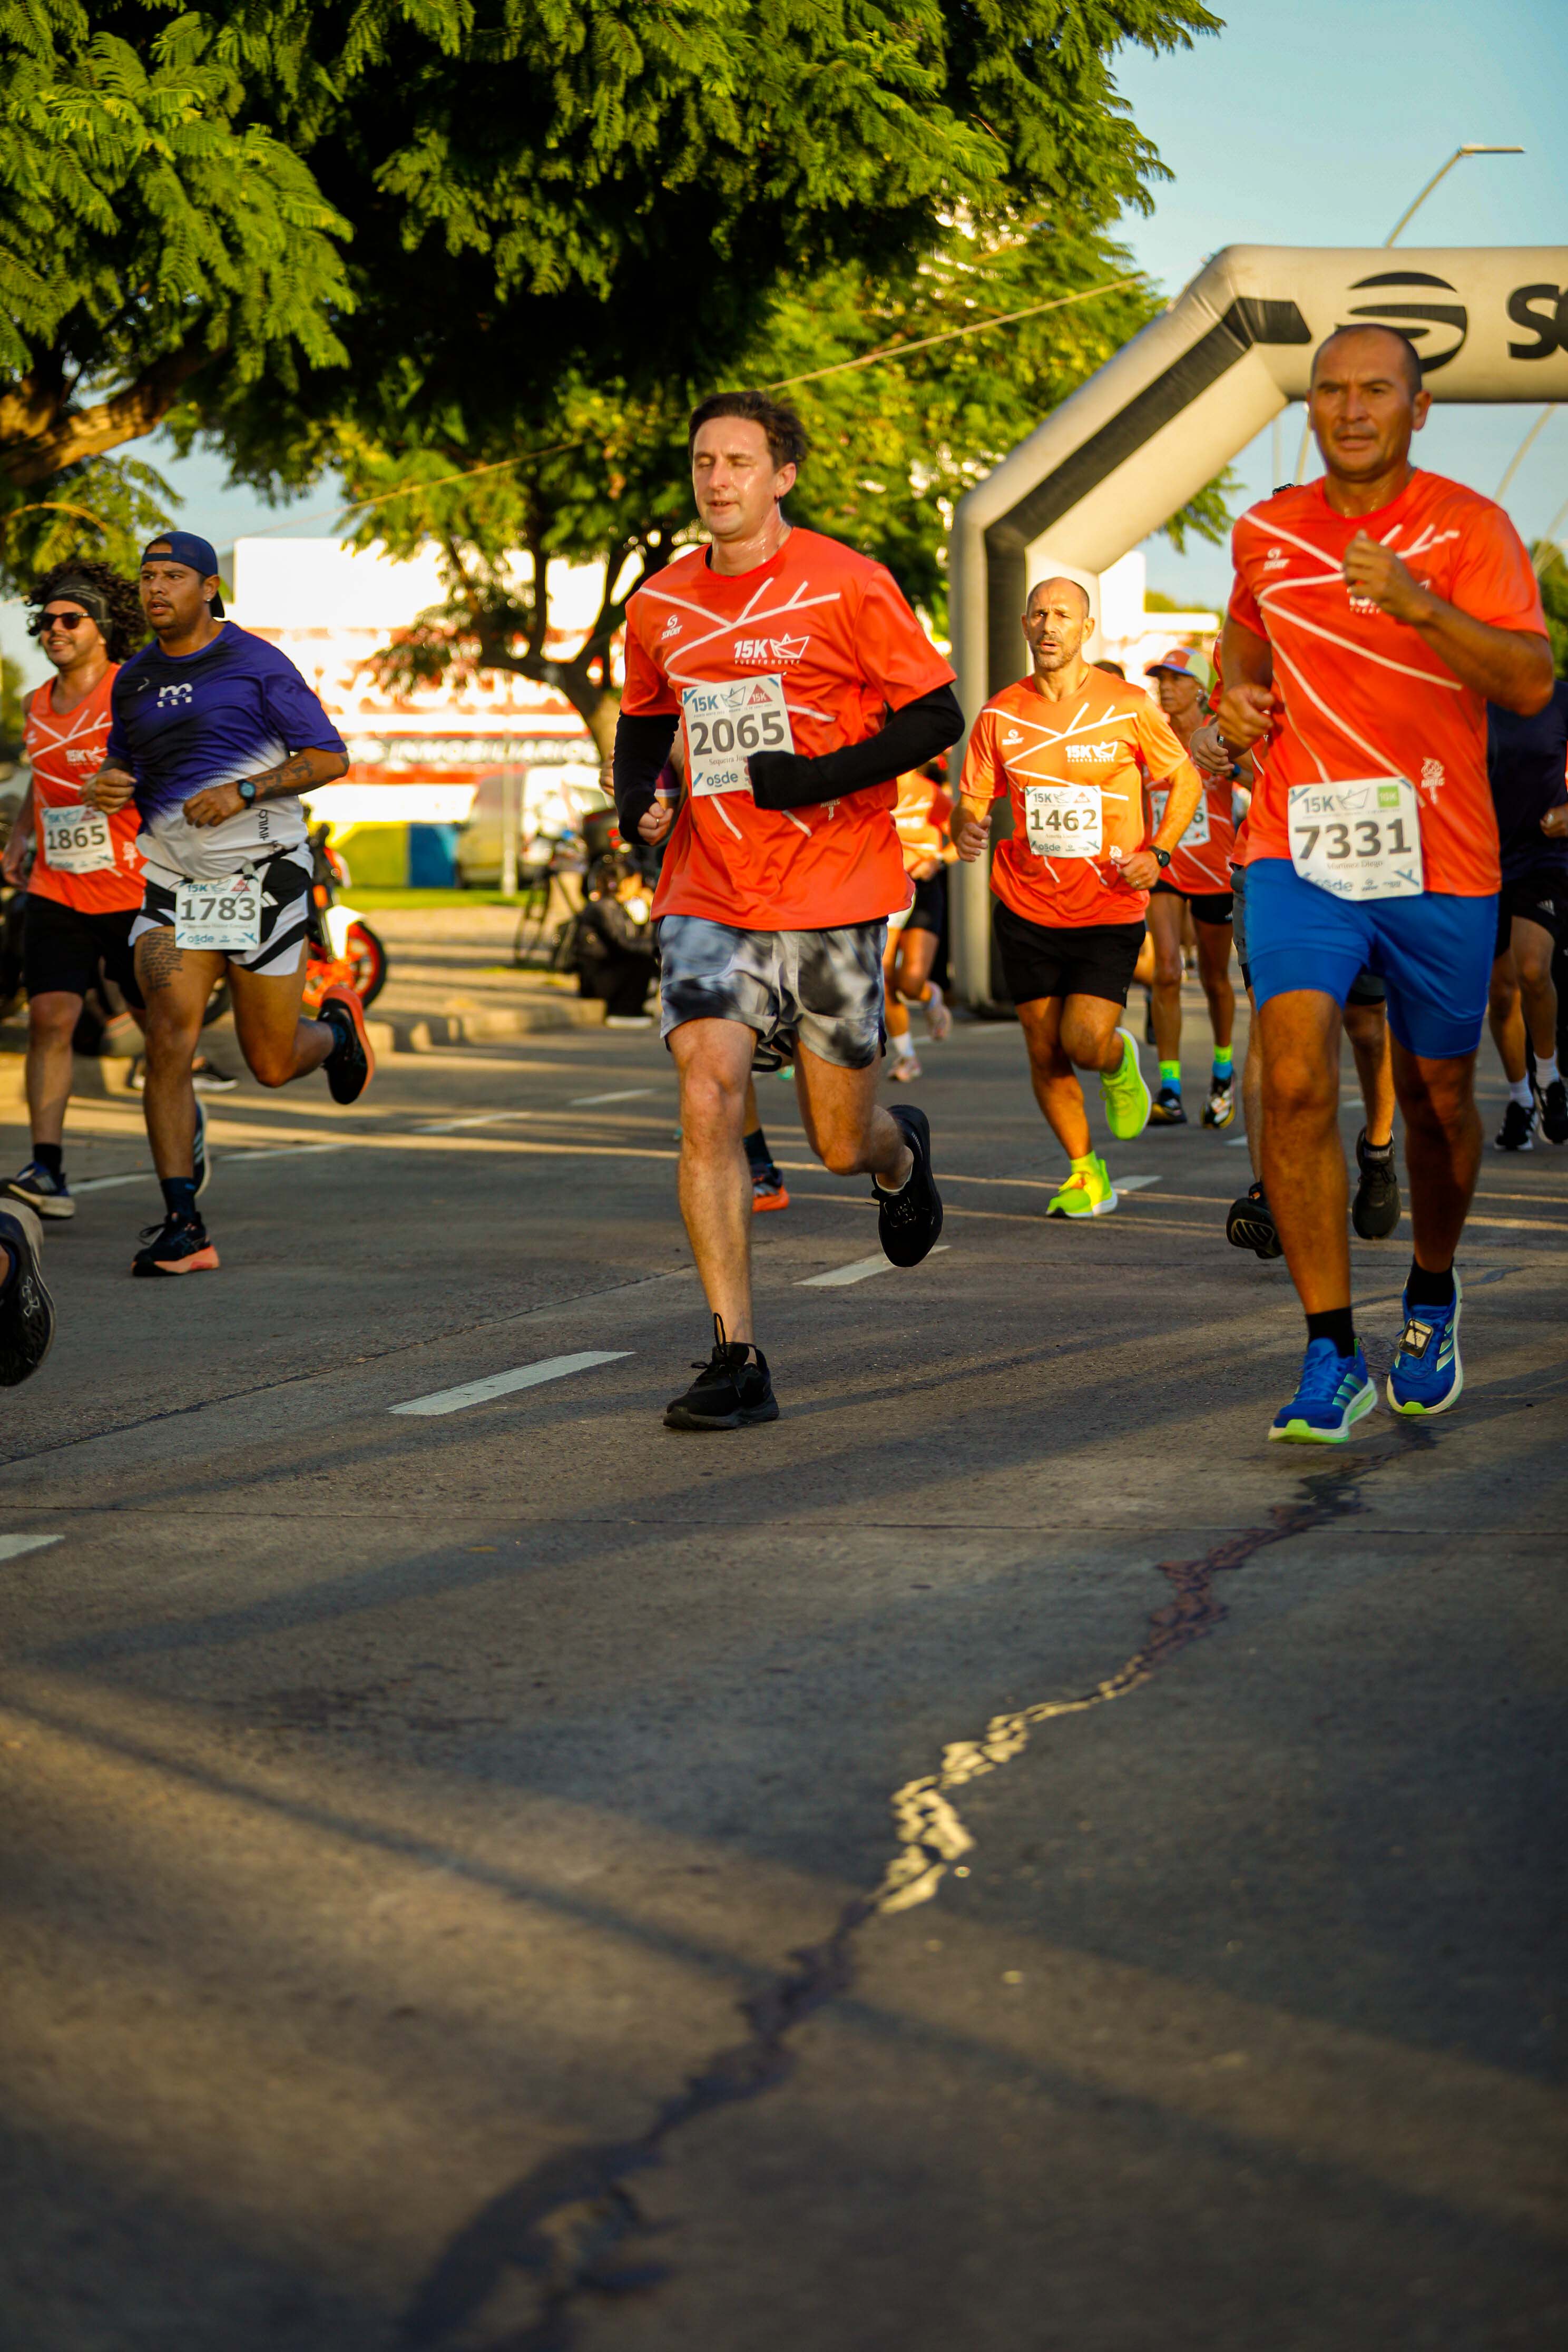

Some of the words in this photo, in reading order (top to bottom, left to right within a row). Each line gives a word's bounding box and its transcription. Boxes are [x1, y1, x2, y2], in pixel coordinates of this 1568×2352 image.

[734, 639, 768, 659] 15K
[692, 694, 719, 712] 15K
[751, 692, 767, 702] 15K
[691, 711, 785, 756] 2065
[1065, 745, 1092, 758] 15K
[707, 771, 738, 787] osde
[1033, 793, 1052, 803] 15K
[1302, 795, 1335, 813] 15K
[1031, 809, 1097, 831] 1462
[48, 825, 105, 849] 1865
[1295, 818, 1412, 860] 7331
[1038, 844, 1061, 852] osde
[188, 884, 208, 892] 15K
[181, 897, 256, 920] 1783
[188, 934, 214, 945] osde
